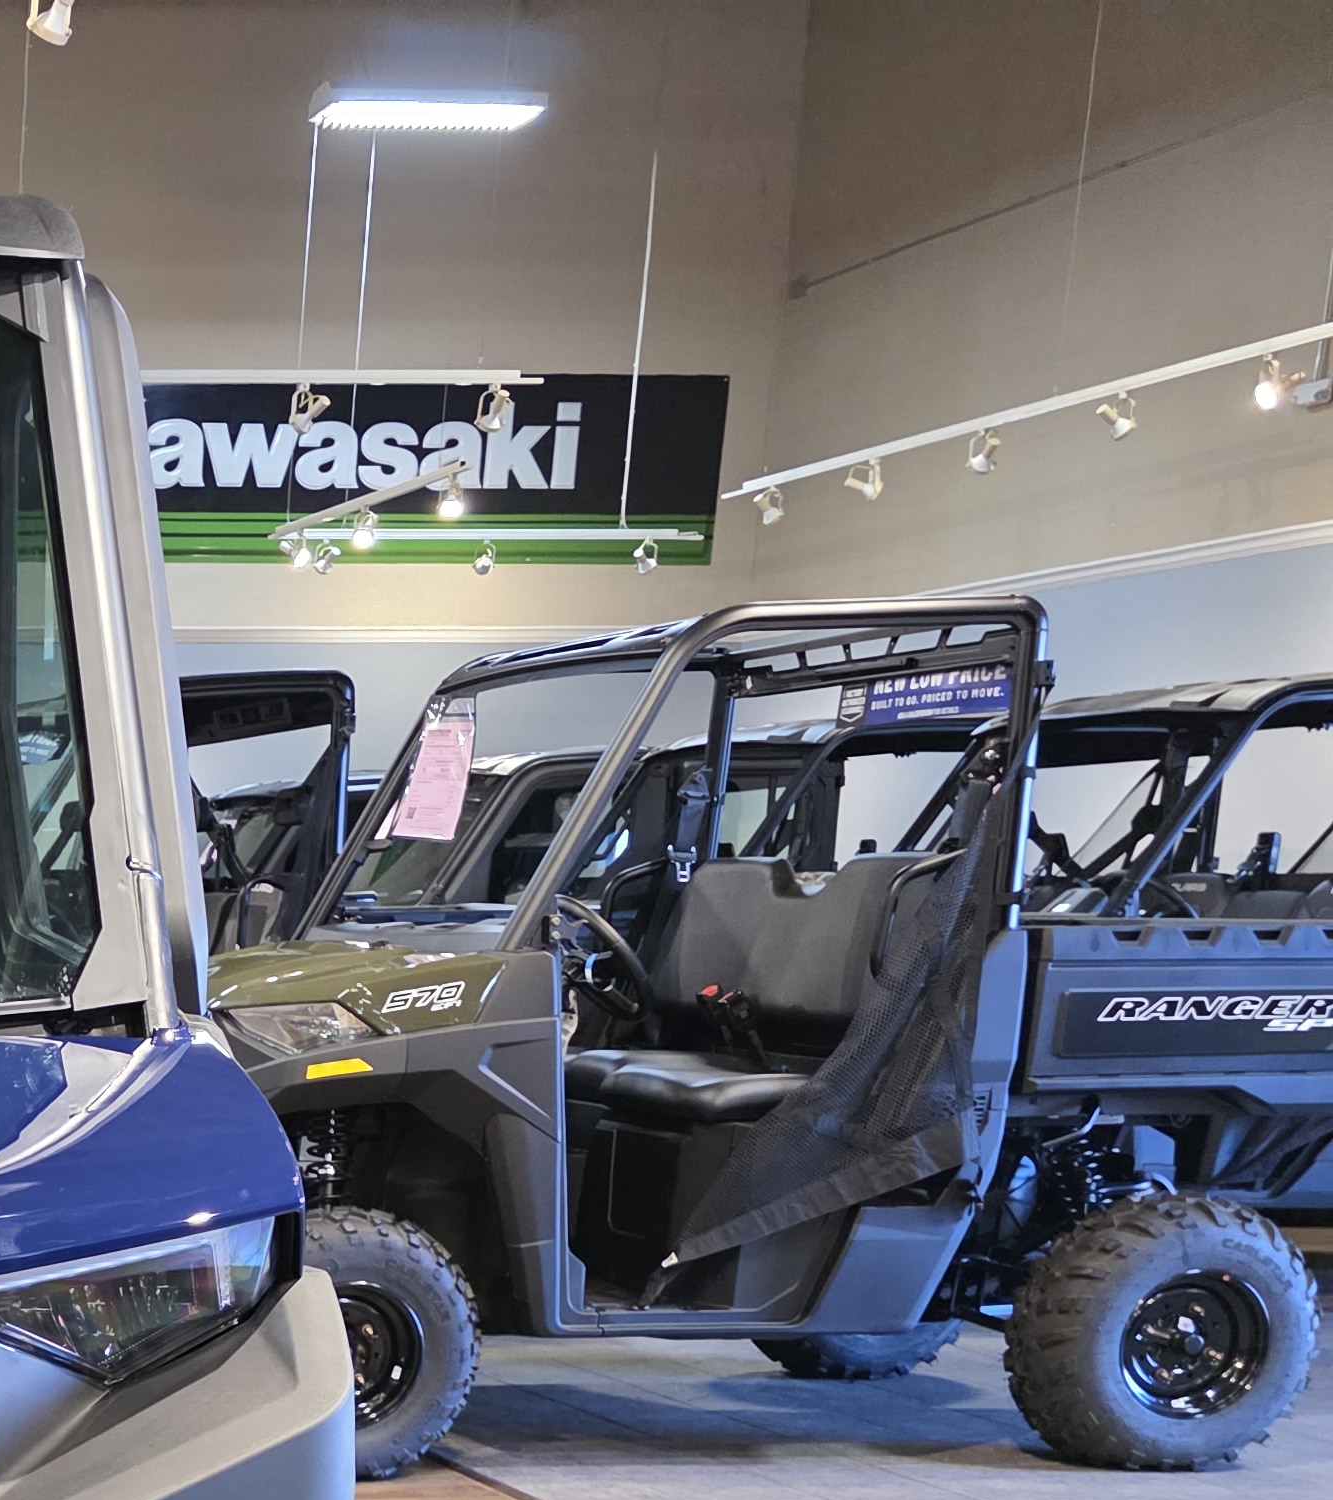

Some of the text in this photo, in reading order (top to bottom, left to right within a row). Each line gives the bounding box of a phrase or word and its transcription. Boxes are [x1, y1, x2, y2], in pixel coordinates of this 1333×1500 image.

[147, 401, 582, 491] awasaki
[870, 698, 894, 711] BUILT
[894, 697, 905, 707] TO
[921, 690, 953, 704] PRICED
[956, 689, 969, 700] TO
[971, 686, 1005, 699] MOVE.
[381, 980, 465, 1014] 570
[1096, 994, 1333, 1022] RANGER
